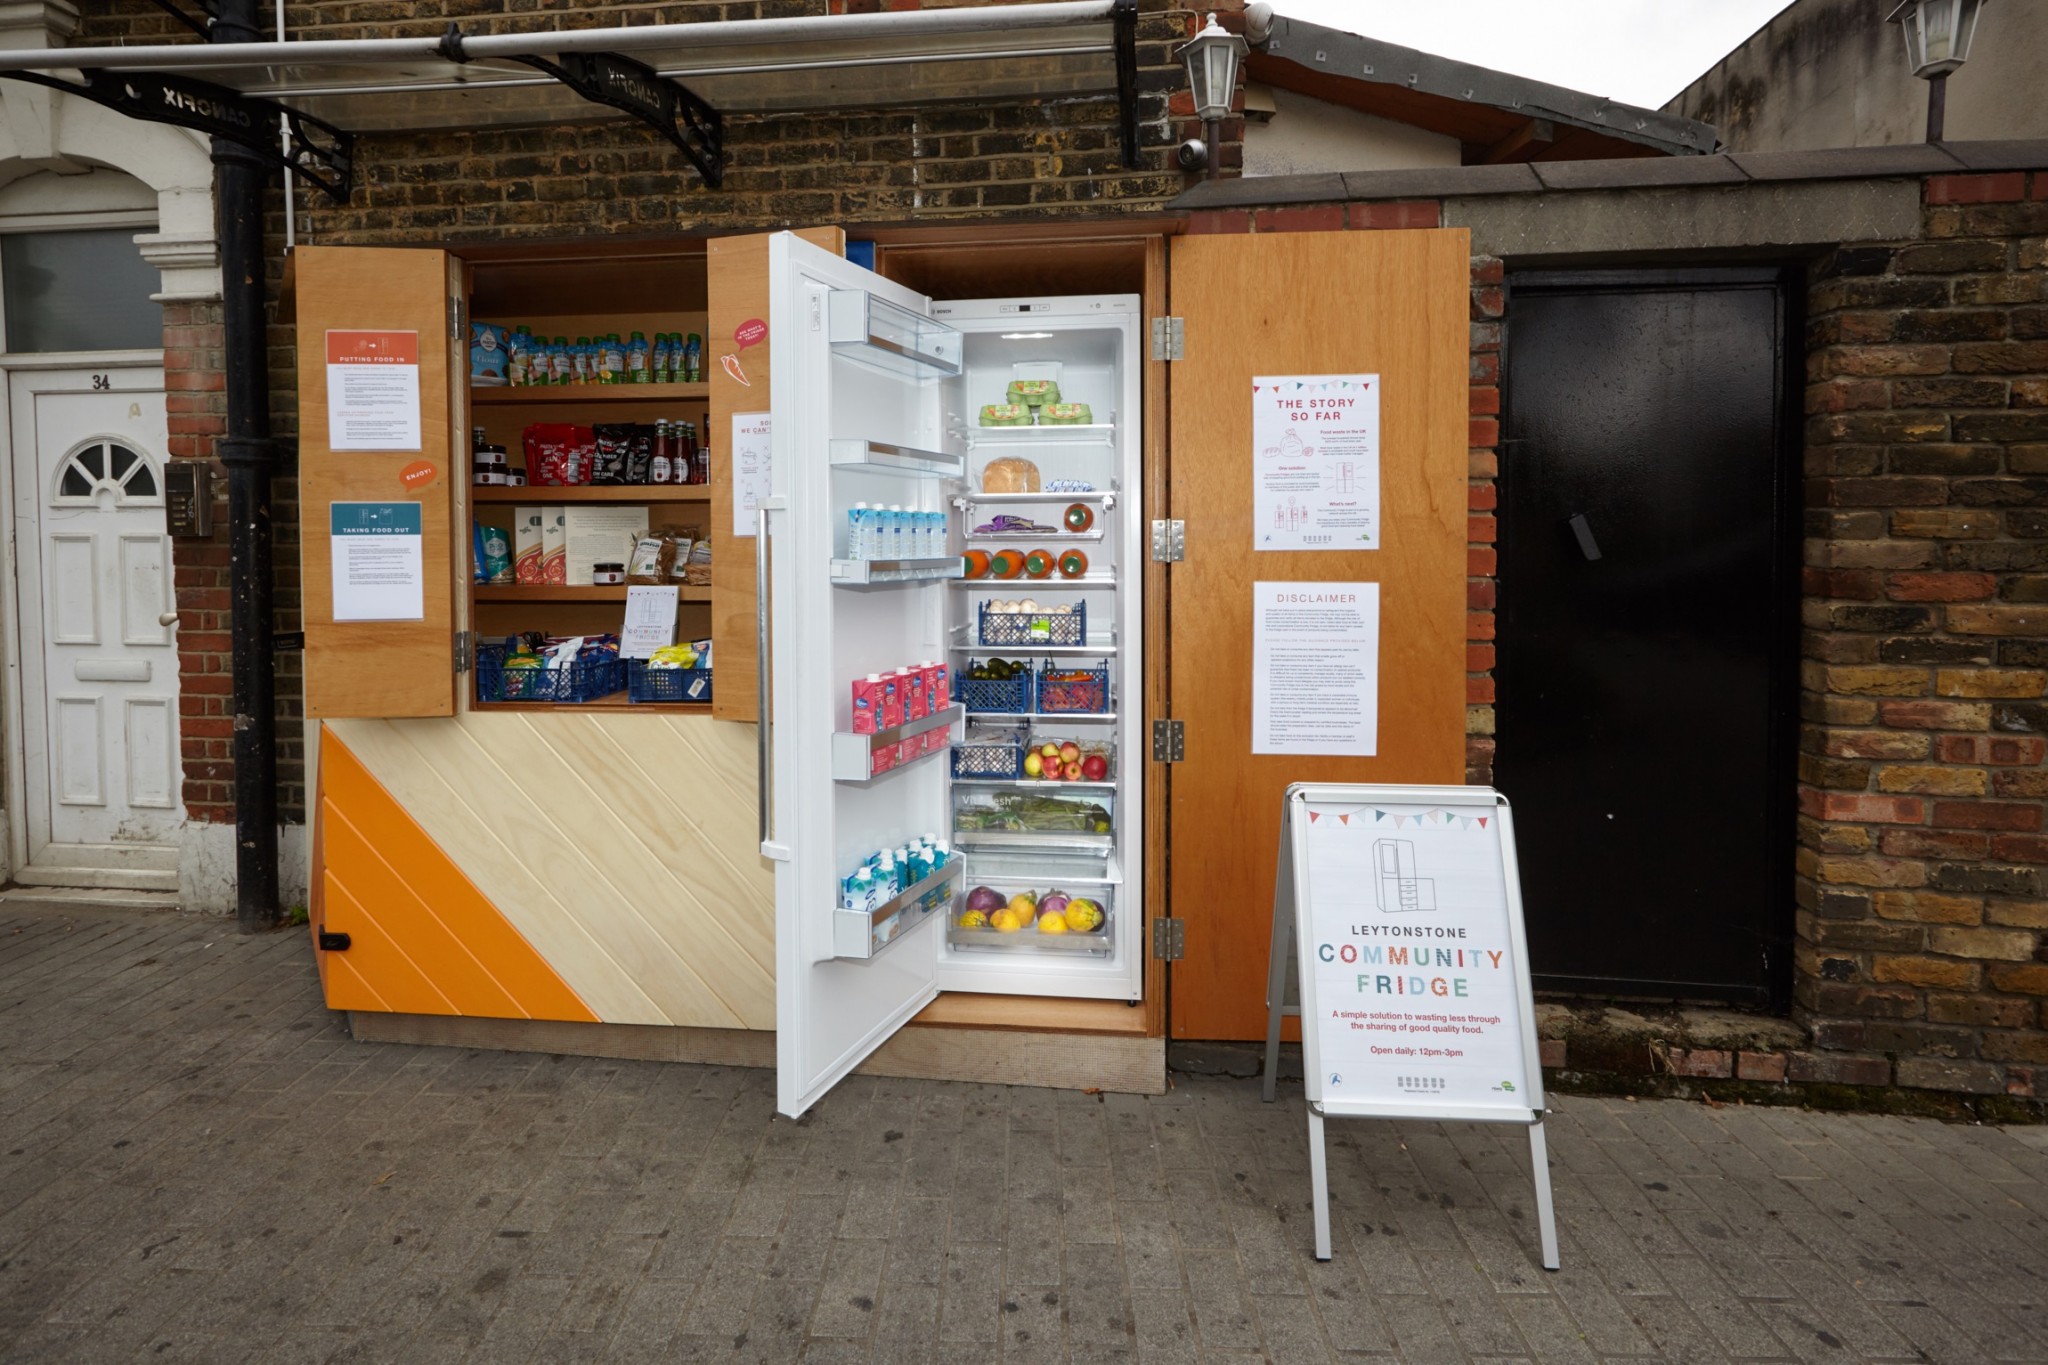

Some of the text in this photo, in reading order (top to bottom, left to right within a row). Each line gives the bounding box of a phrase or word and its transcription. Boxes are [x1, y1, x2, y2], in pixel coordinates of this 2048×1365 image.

[92, 374, 111, 390] 34
[1277, 399, 1355, 408] THE STORY
[1291, 411, 1341, 421] SO FAR
[406, 468, 432, 481] ENJOY!
[1277, 594, 1356, 603] DISCLAIMER
[1351, 925, 1467, 938] LEYTONSTONE
[1318, 943, 1503, 969] COMMUNITY
[1357, 974, 1469, 997] FRIDGE
[1332, 1010, 1501, 1025] A simple solution to wasting less through
[1351, 1022, 1484, 1034] the sharing of good quality food.
[1370, 1046, 1463, 1058] Open daily: 12pm-3pm
